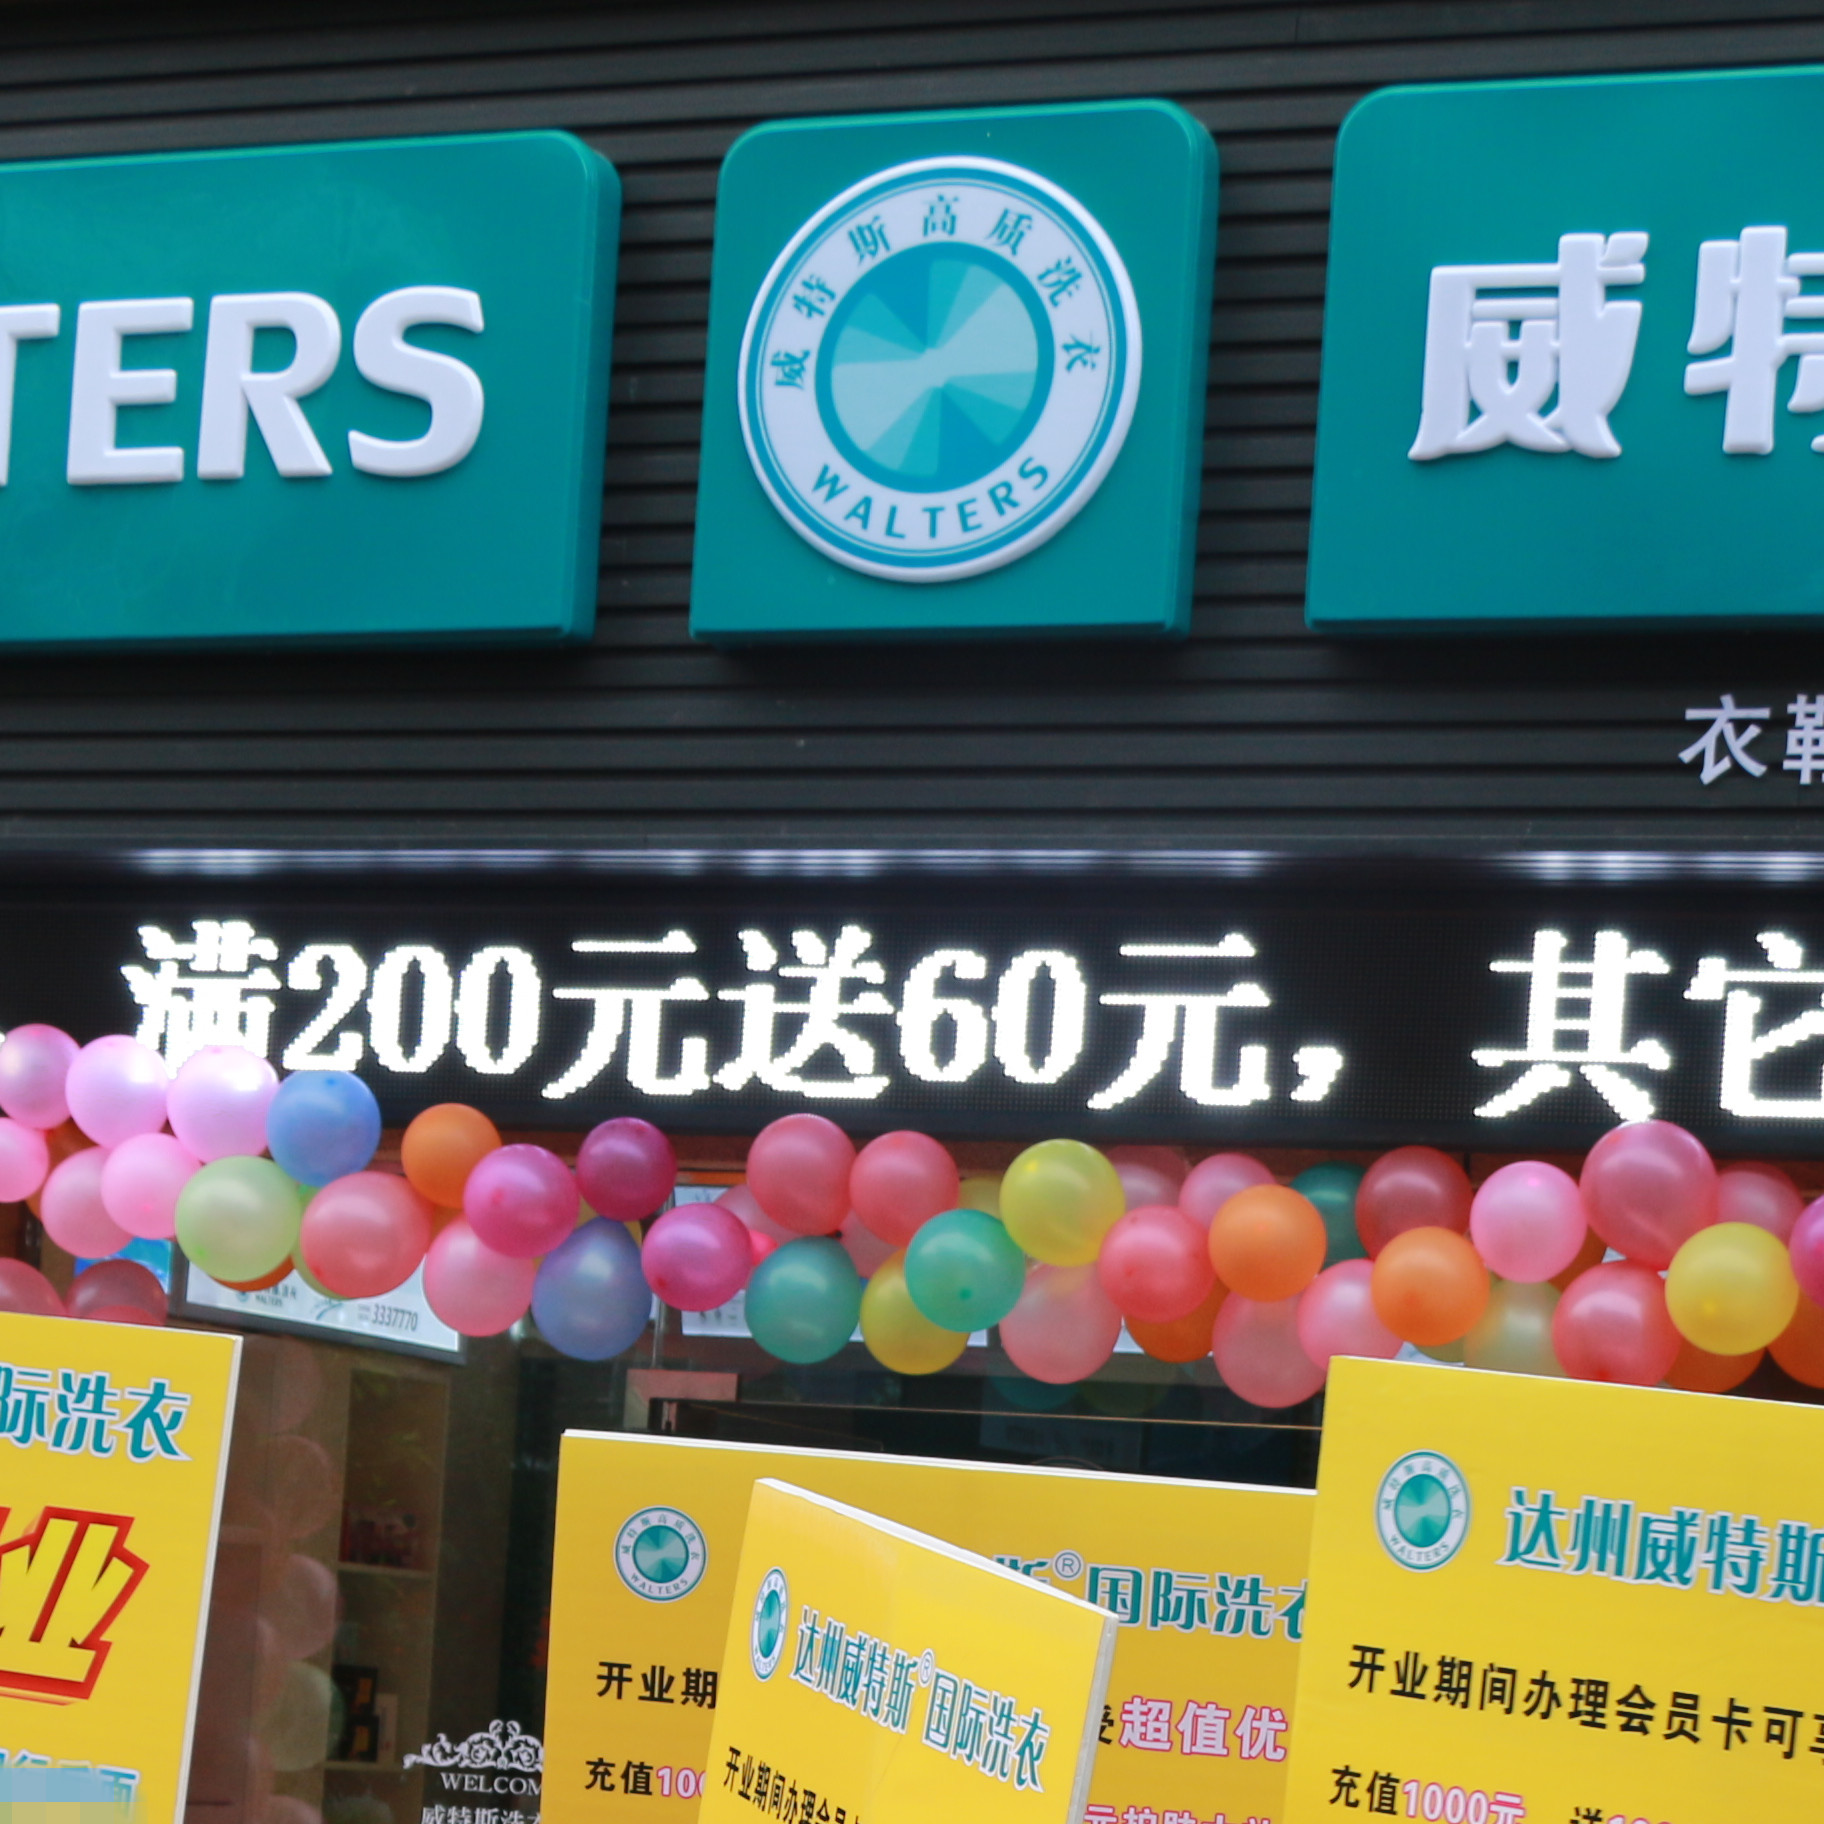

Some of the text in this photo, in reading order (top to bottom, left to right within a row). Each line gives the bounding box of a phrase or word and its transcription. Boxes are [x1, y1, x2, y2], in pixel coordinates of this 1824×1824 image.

[771, 194, 1102, 390] 威特斯高质洗衣
[811, 455, 1049, 540] WALTERS
[372, 1303, 418, 1331] 3337770
[630, 1573, 689, 1595] WALTERS
[585, 1757, 706, 1800] 充值10
